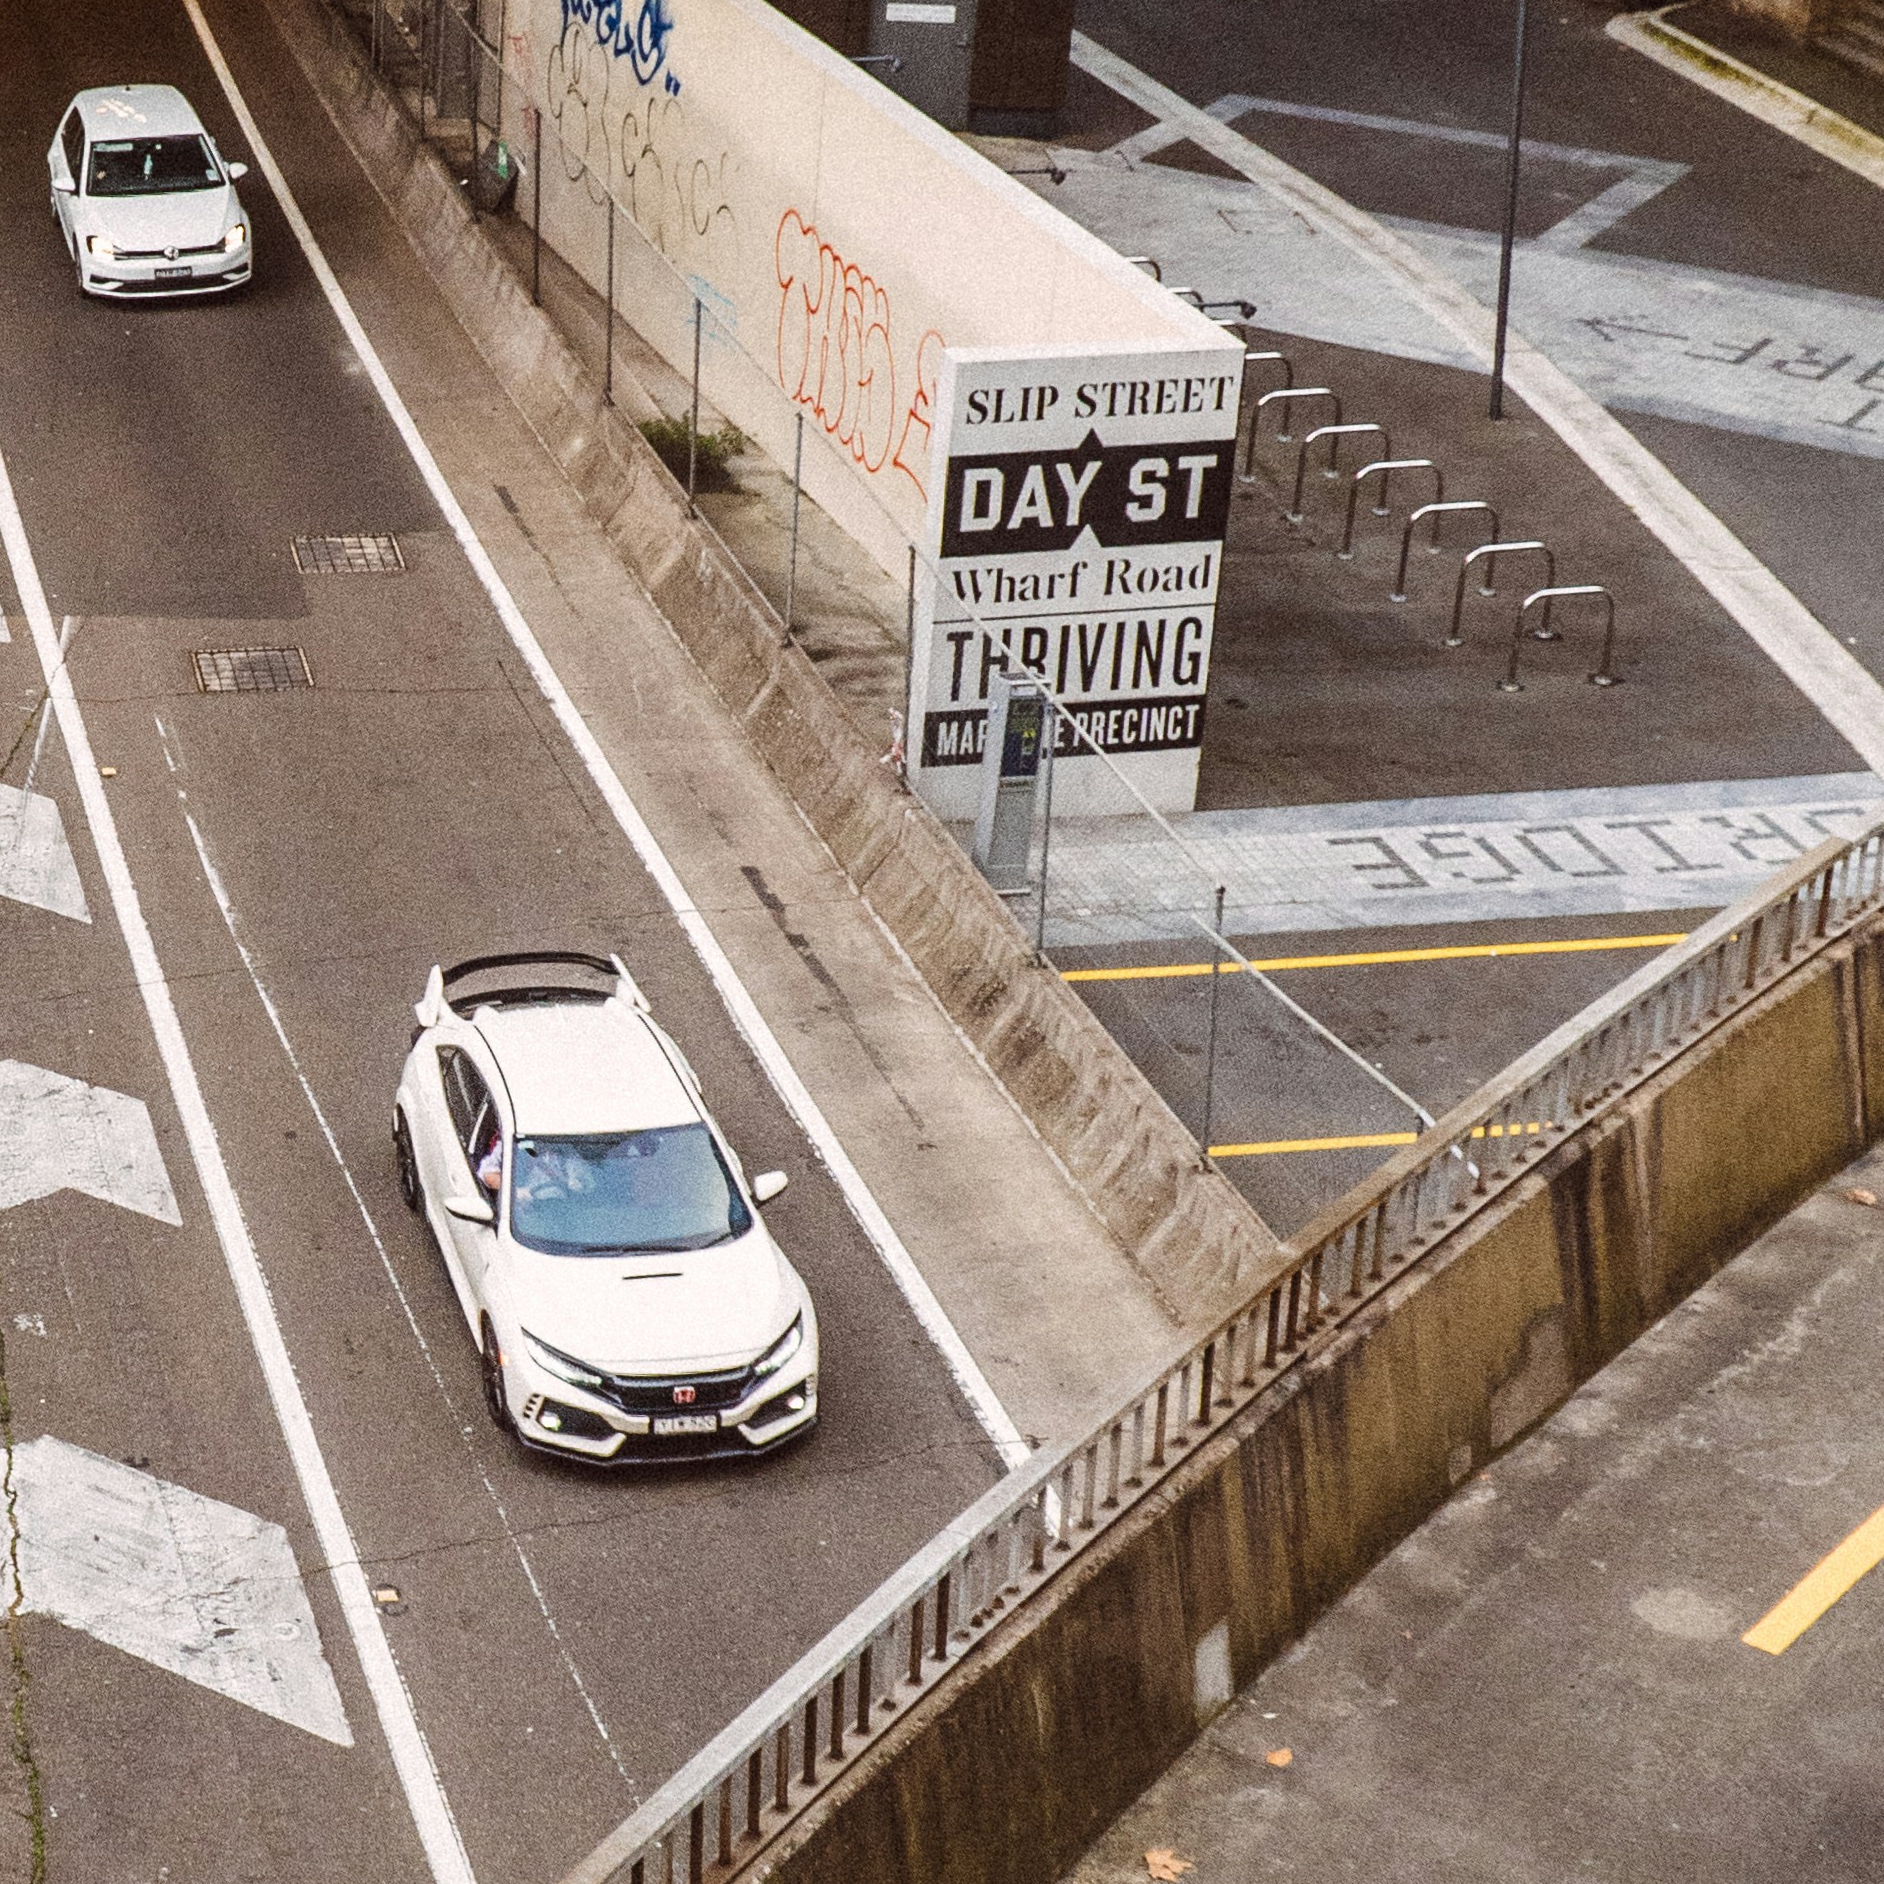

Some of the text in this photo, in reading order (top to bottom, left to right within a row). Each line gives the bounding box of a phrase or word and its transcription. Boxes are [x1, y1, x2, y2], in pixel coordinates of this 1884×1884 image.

[966, 376, 1235, 425] SLIP STREET
[959, 455, 1218, 534] DAY ST
[953, 554, 1212, 605] Wharf Road
[1072, 704, 1201, 748] PRECINCT
